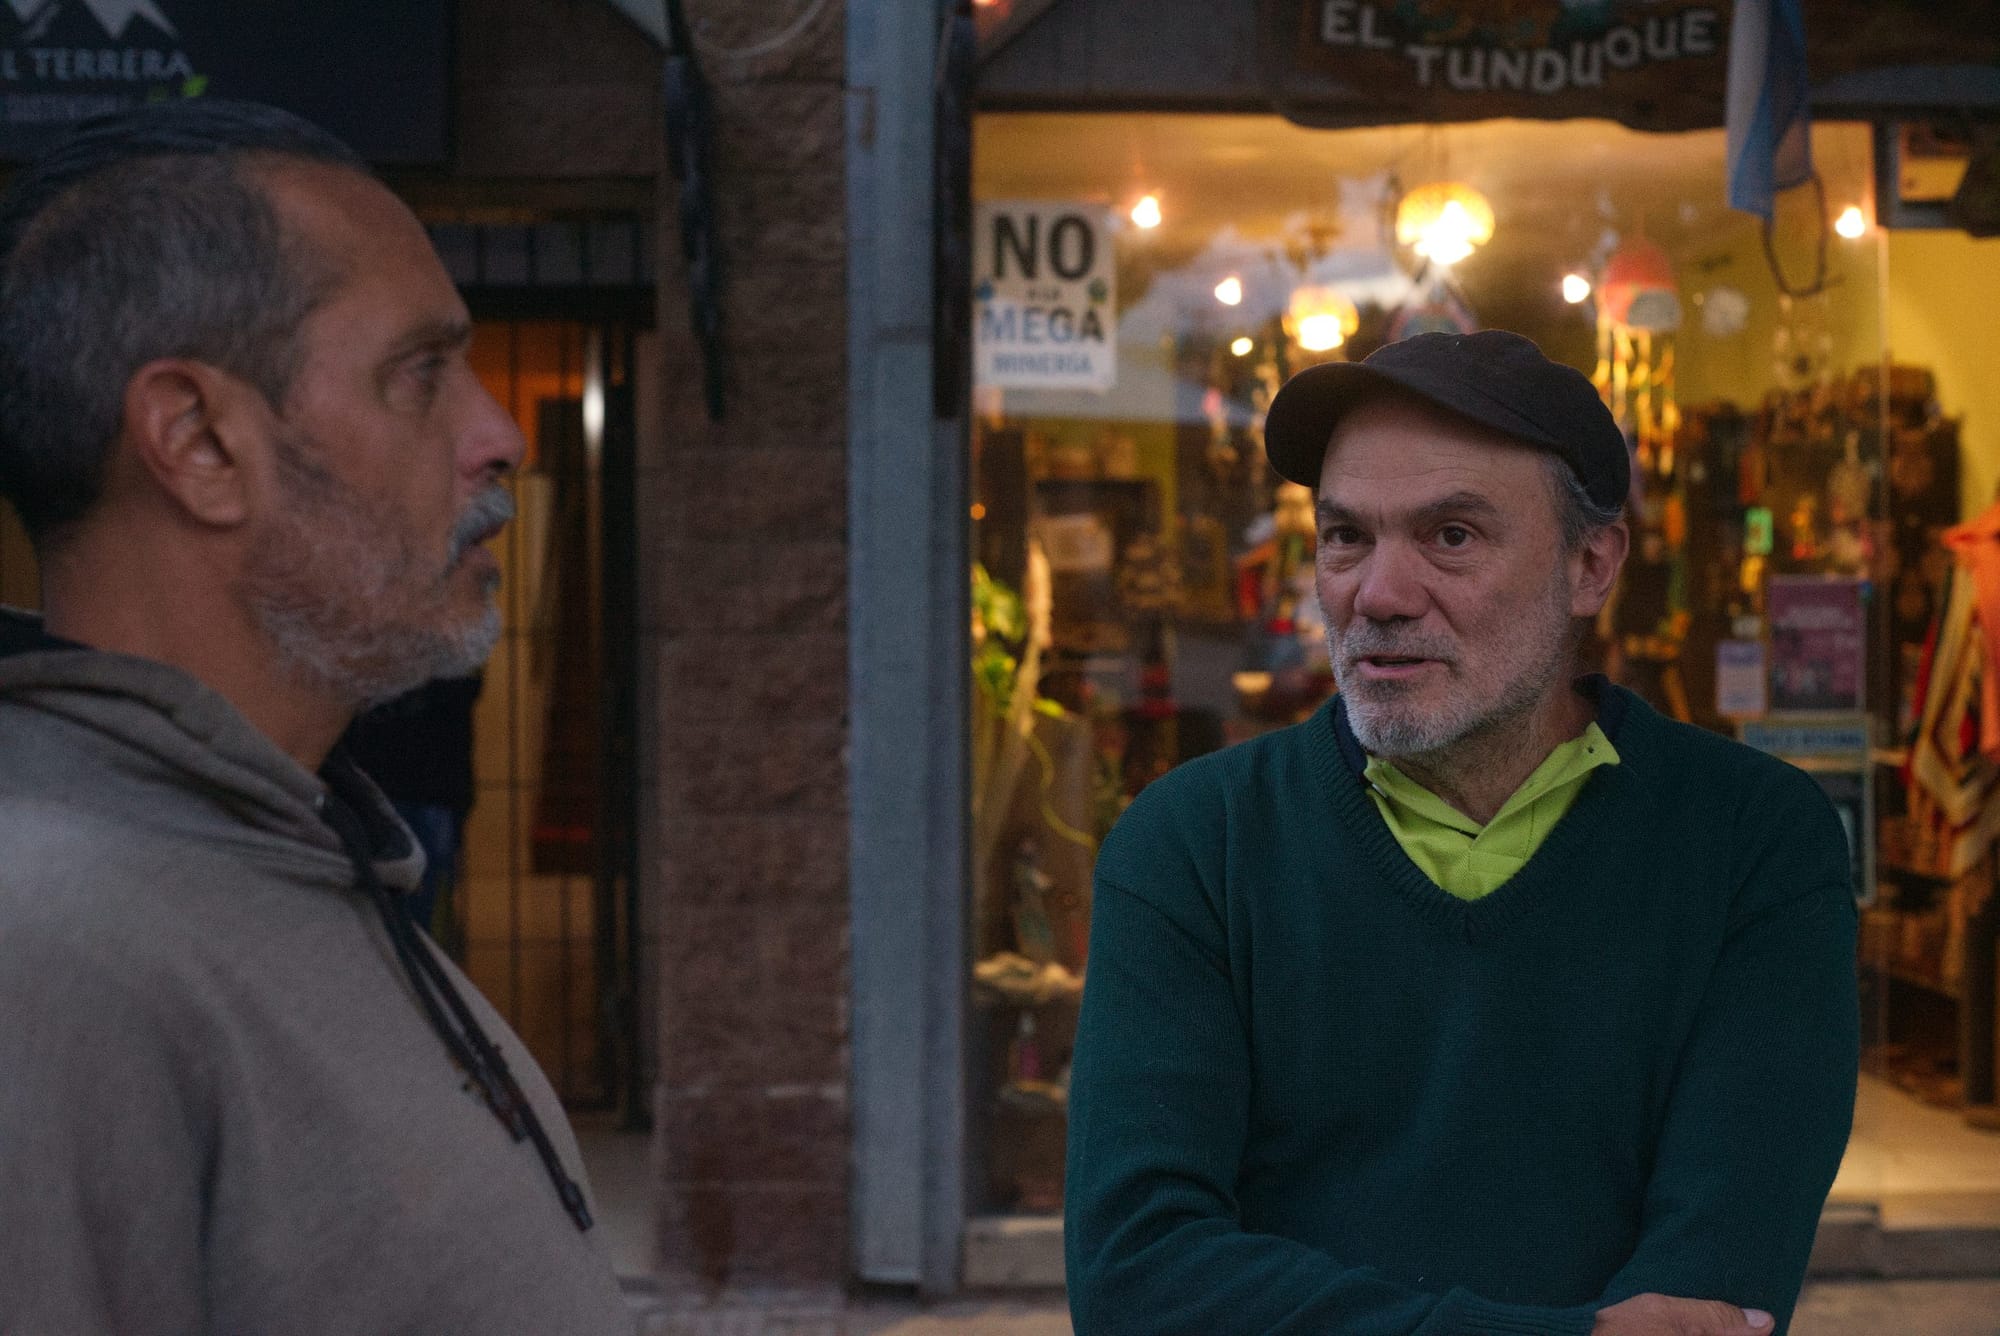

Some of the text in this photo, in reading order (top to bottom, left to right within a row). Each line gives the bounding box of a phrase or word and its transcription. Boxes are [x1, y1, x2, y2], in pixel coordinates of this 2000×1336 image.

[1319, 0, 1394, 48] EL
[0, 48, 193, 80] L TERRERA
[993, 212, 1097, 281] NO
[980, 306, 1105, 344] MEGA
